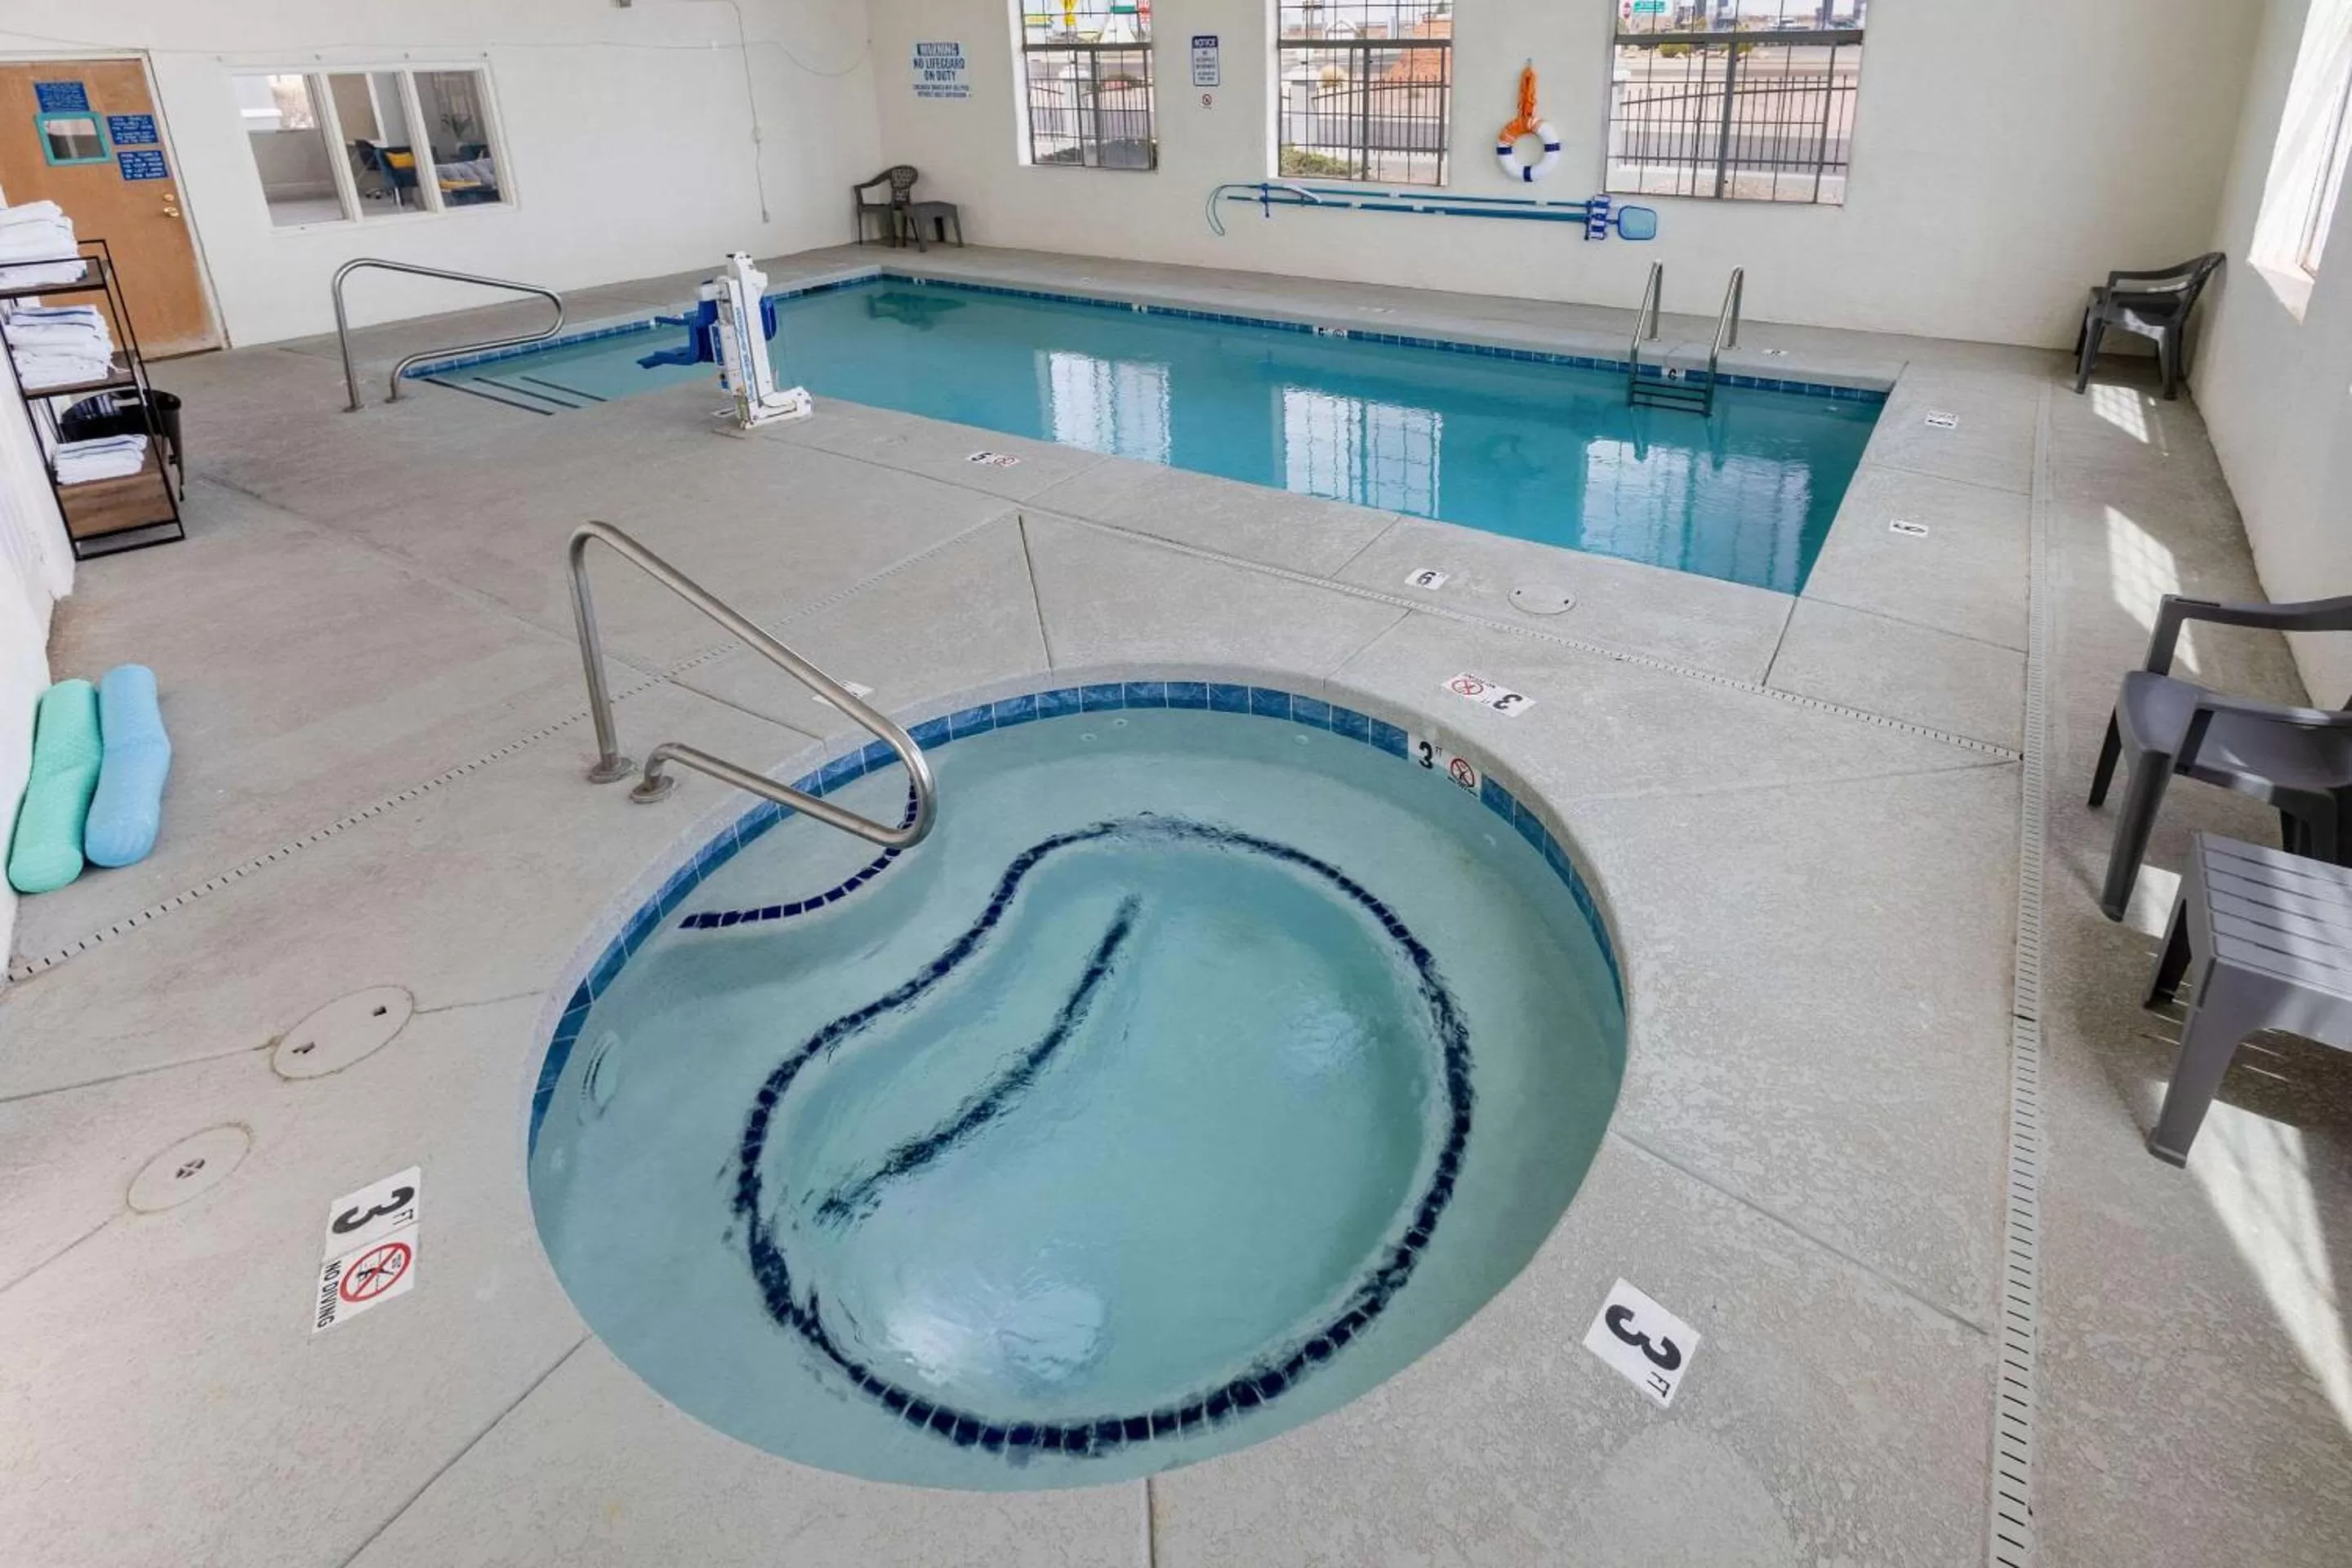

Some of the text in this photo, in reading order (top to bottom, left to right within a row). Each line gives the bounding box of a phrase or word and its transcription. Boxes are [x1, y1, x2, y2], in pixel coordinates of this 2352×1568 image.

[914, 58, 924, 69] NO
[1493, 693, 1524, 710] 3
[1419, 741, 1432, 769] 3
[332, 1186, 415, 1235] 3
[316, 1259, 341, 1329] NO DIVING
[1605, 1303, 1682, 1398] 3 FT
